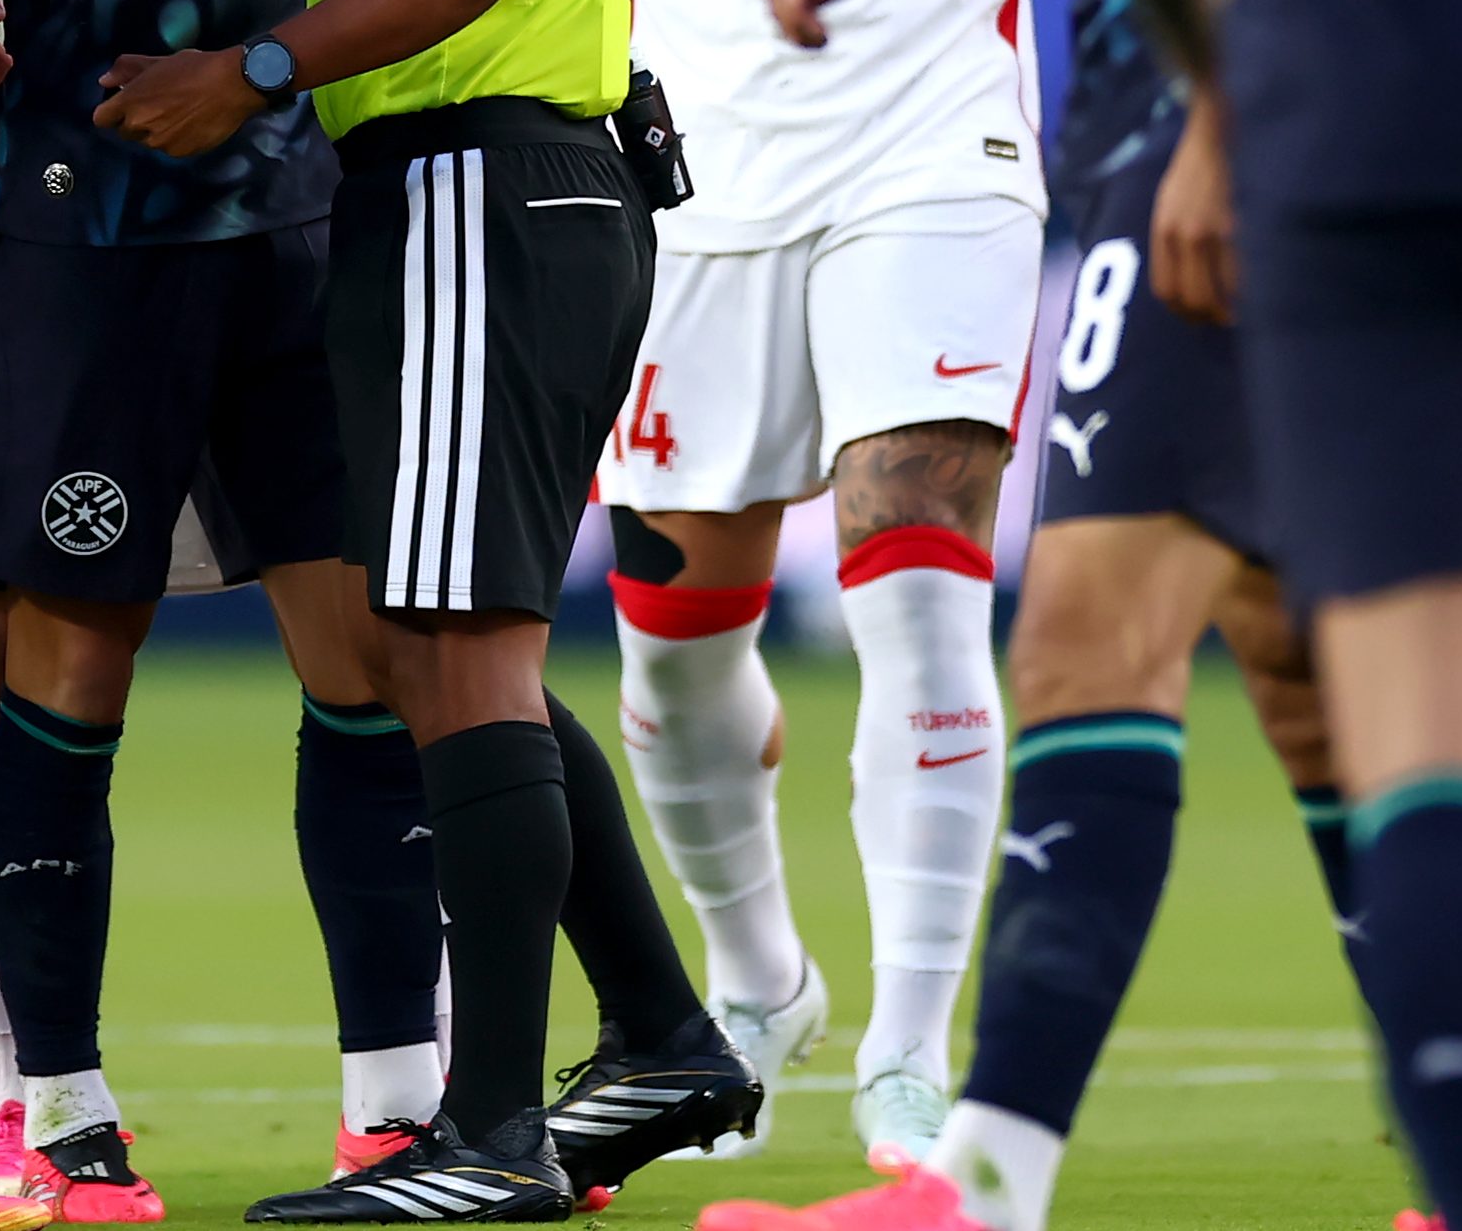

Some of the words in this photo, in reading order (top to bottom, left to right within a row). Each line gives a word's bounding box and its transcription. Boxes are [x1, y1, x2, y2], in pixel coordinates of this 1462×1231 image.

[1059, 236, 1142, 395] 8
[73, 478, 103, 494] APF
[62, 537, 101, 550] PARAGUAY
